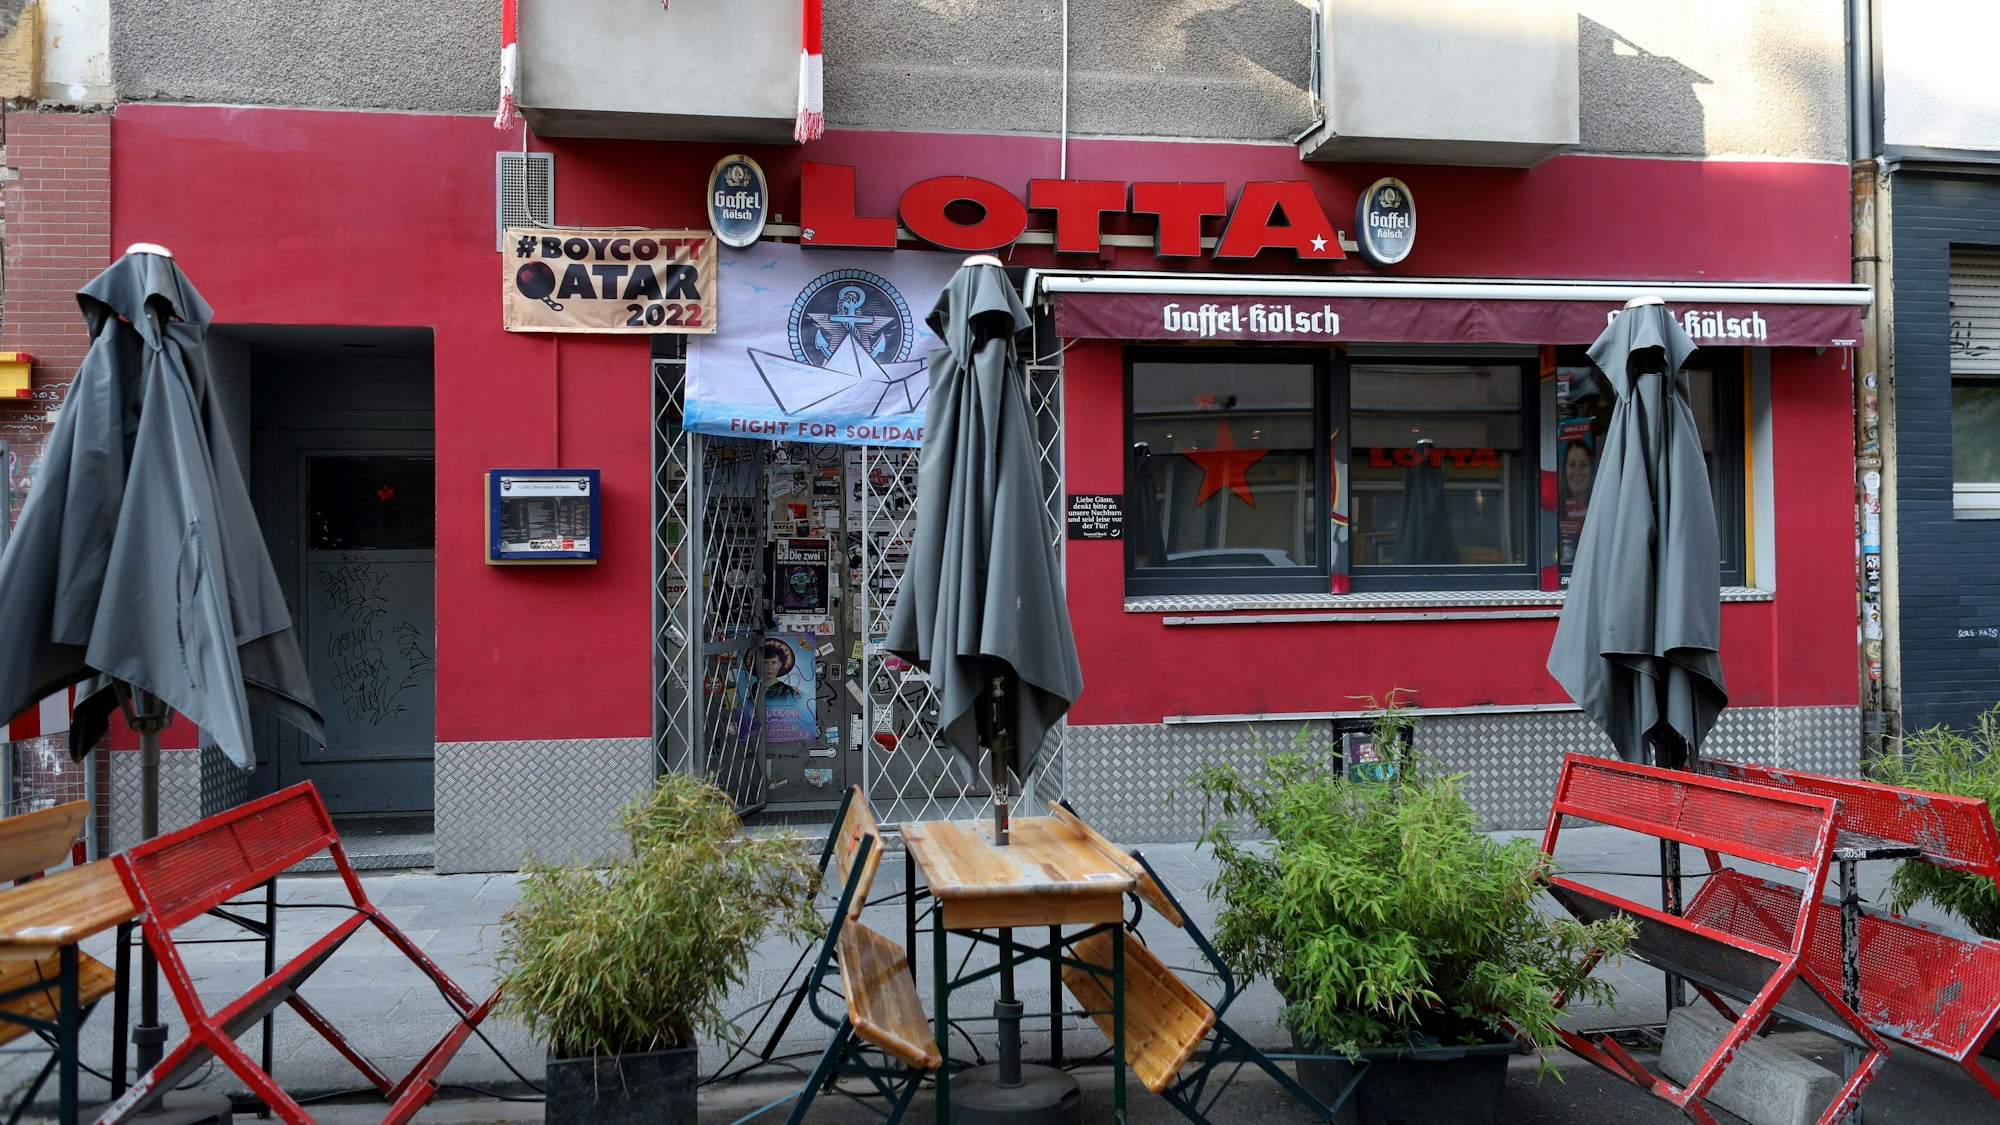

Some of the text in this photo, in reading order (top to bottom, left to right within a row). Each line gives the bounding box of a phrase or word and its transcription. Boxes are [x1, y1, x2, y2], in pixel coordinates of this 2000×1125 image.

[714, 190, 761, 210] Gaffel
[800, 161, 1346, 260] LOTTA
[723, 209, 752, 220] Kölsch
[1370, 211, 1410, 229] Gaffel
[1377, 229, 1402, 239] Kölsch
[516, 235, 706, 261] #BOYCOTT
[516, 261, 702, 303] QATAR
[626, 303, 703, 327] 2022
[1163, 303, 1340, 338] Gaffel-Kölsch
[730, 418, 789, 435] FIGHT
[799, 422, 837, 438] FOR
[1369, 446, 1503, 469] LOTTA
[789, 551, 802, 560] Die
